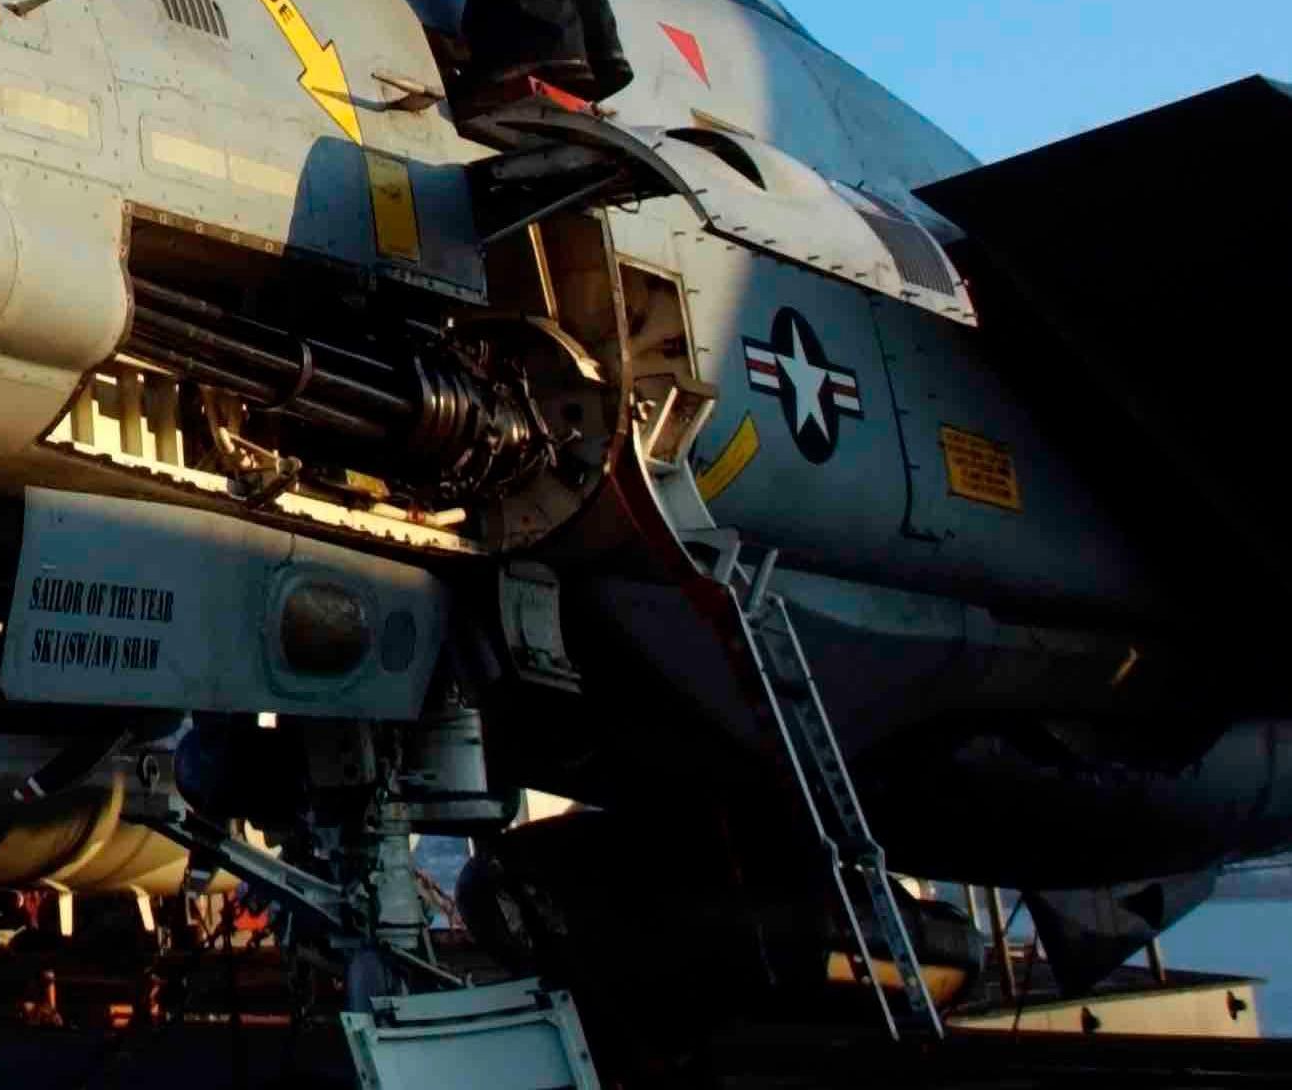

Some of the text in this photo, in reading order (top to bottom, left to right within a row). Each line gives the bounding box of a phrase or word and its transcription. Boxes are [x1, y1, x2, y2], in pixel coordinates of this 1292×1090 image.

[29, 578, 174, 623] SAILOR OF THE YEAR
